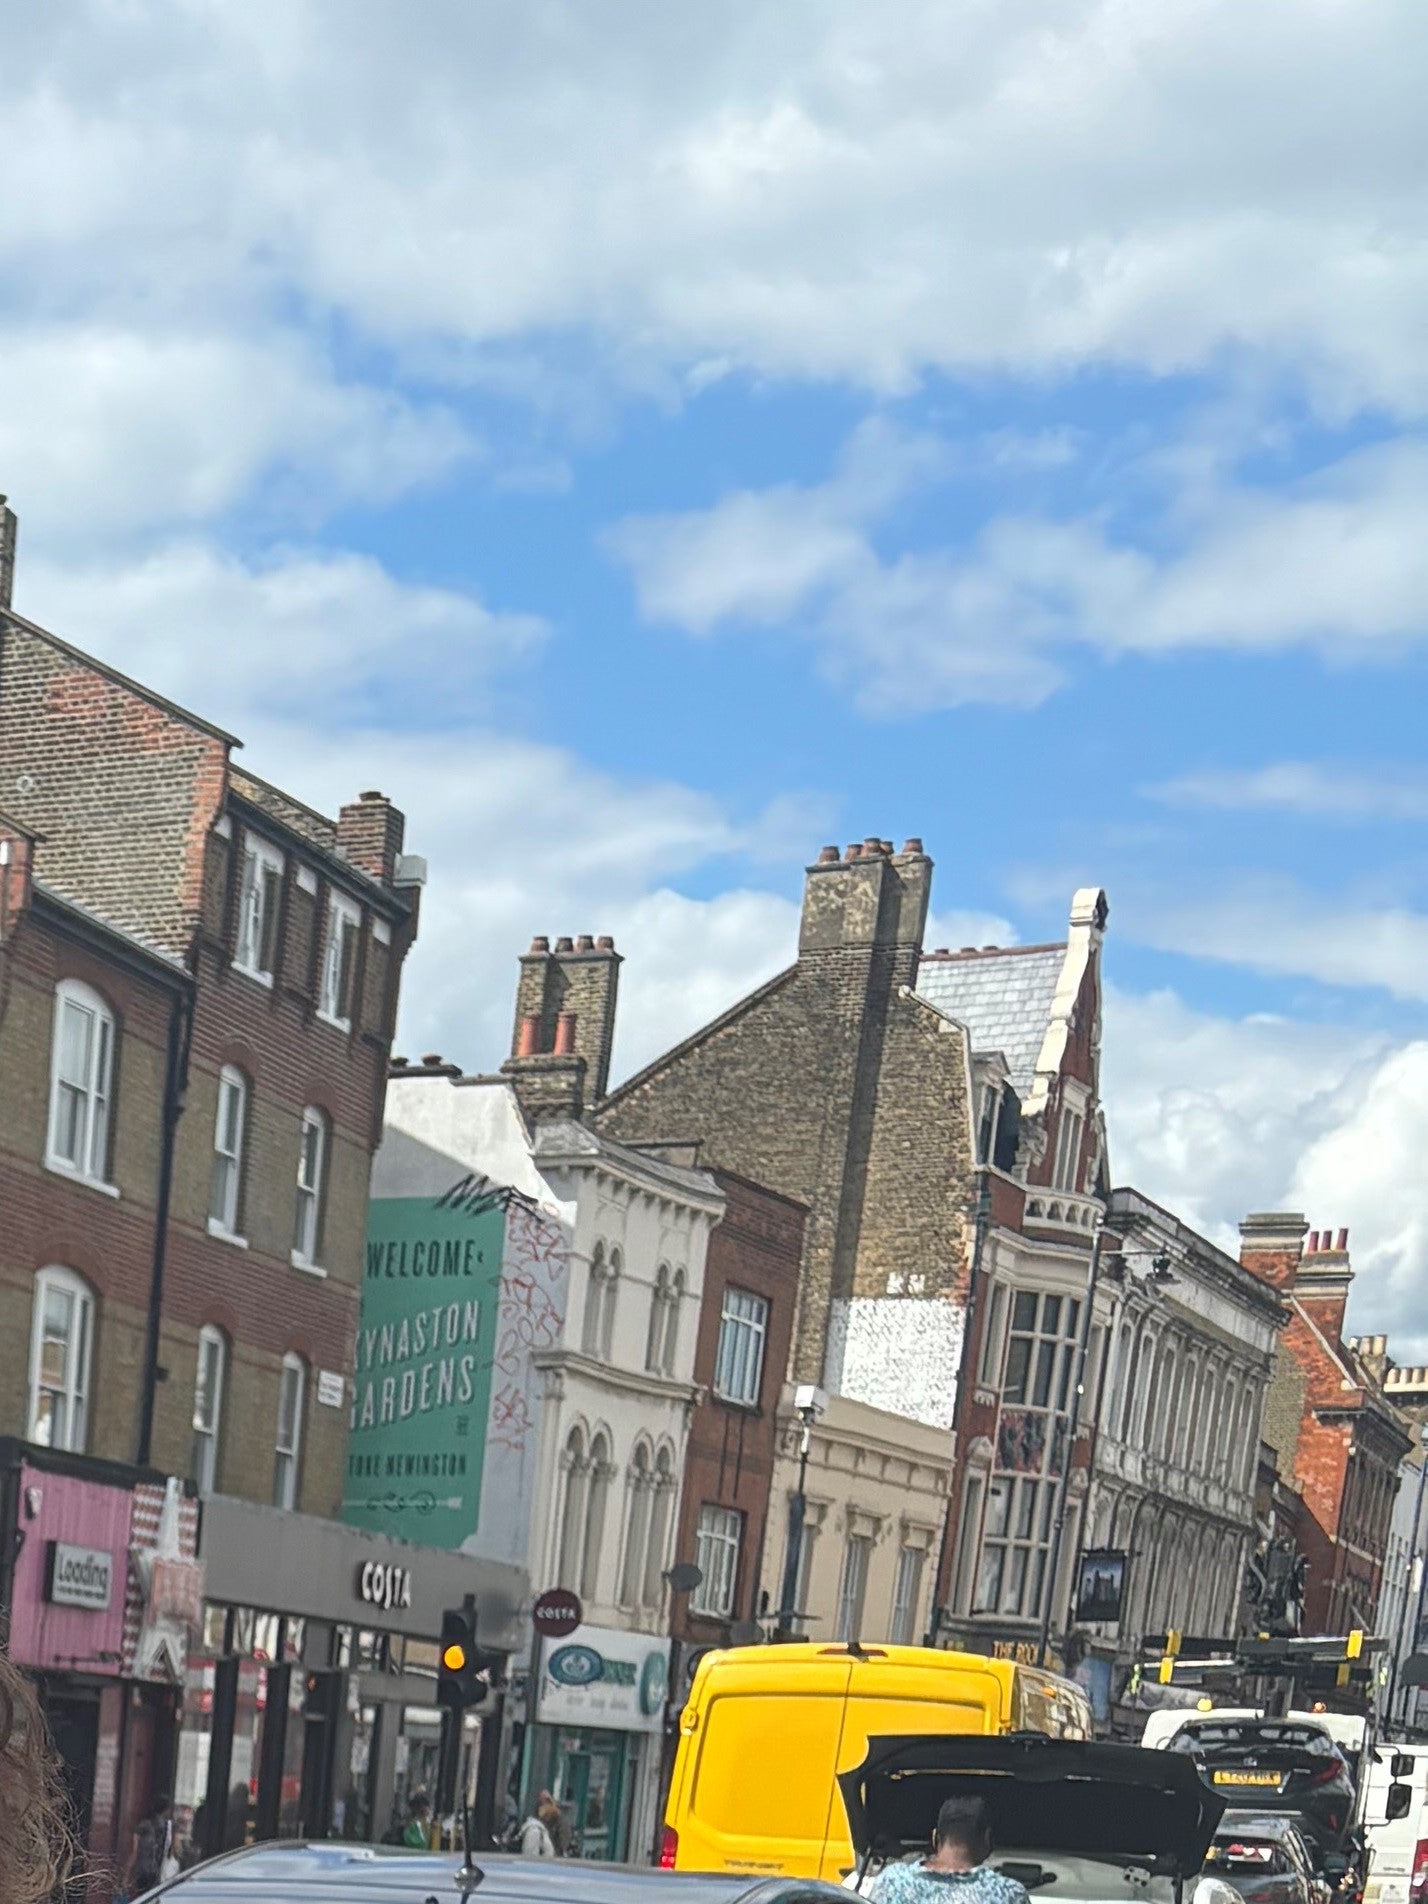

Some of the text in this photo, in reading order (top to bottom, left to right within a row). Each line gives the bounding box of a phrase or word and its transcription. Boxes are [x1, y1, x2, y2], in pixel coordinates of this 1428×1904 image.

[367, 1240, 476, 1279] WELCOME
[349, 1453, 466, 1478] TOKE NEWINGTON
[362, 1561, 411, 1610] COSTA
[536, 1606, 577, 1620] COSTA
